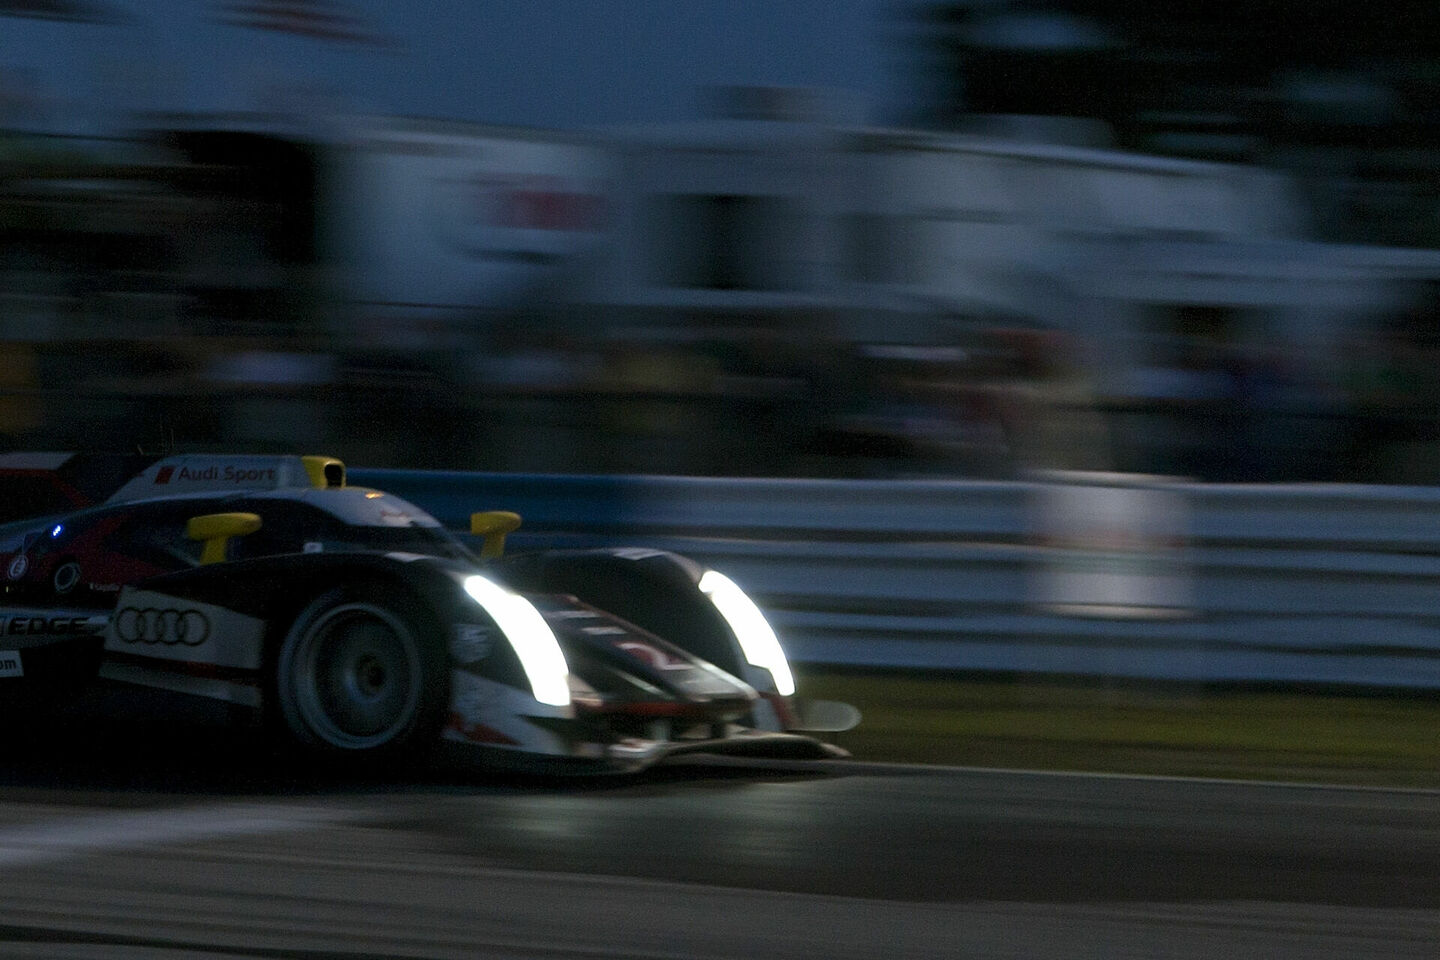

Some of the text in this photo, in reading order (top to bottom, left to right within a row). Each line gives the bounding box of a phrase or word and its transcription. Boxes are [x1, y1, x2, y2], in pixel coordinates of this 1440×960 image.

[179, 466, 274, 483] Audi Sport
[8, 617, 90, 635] EDGE
